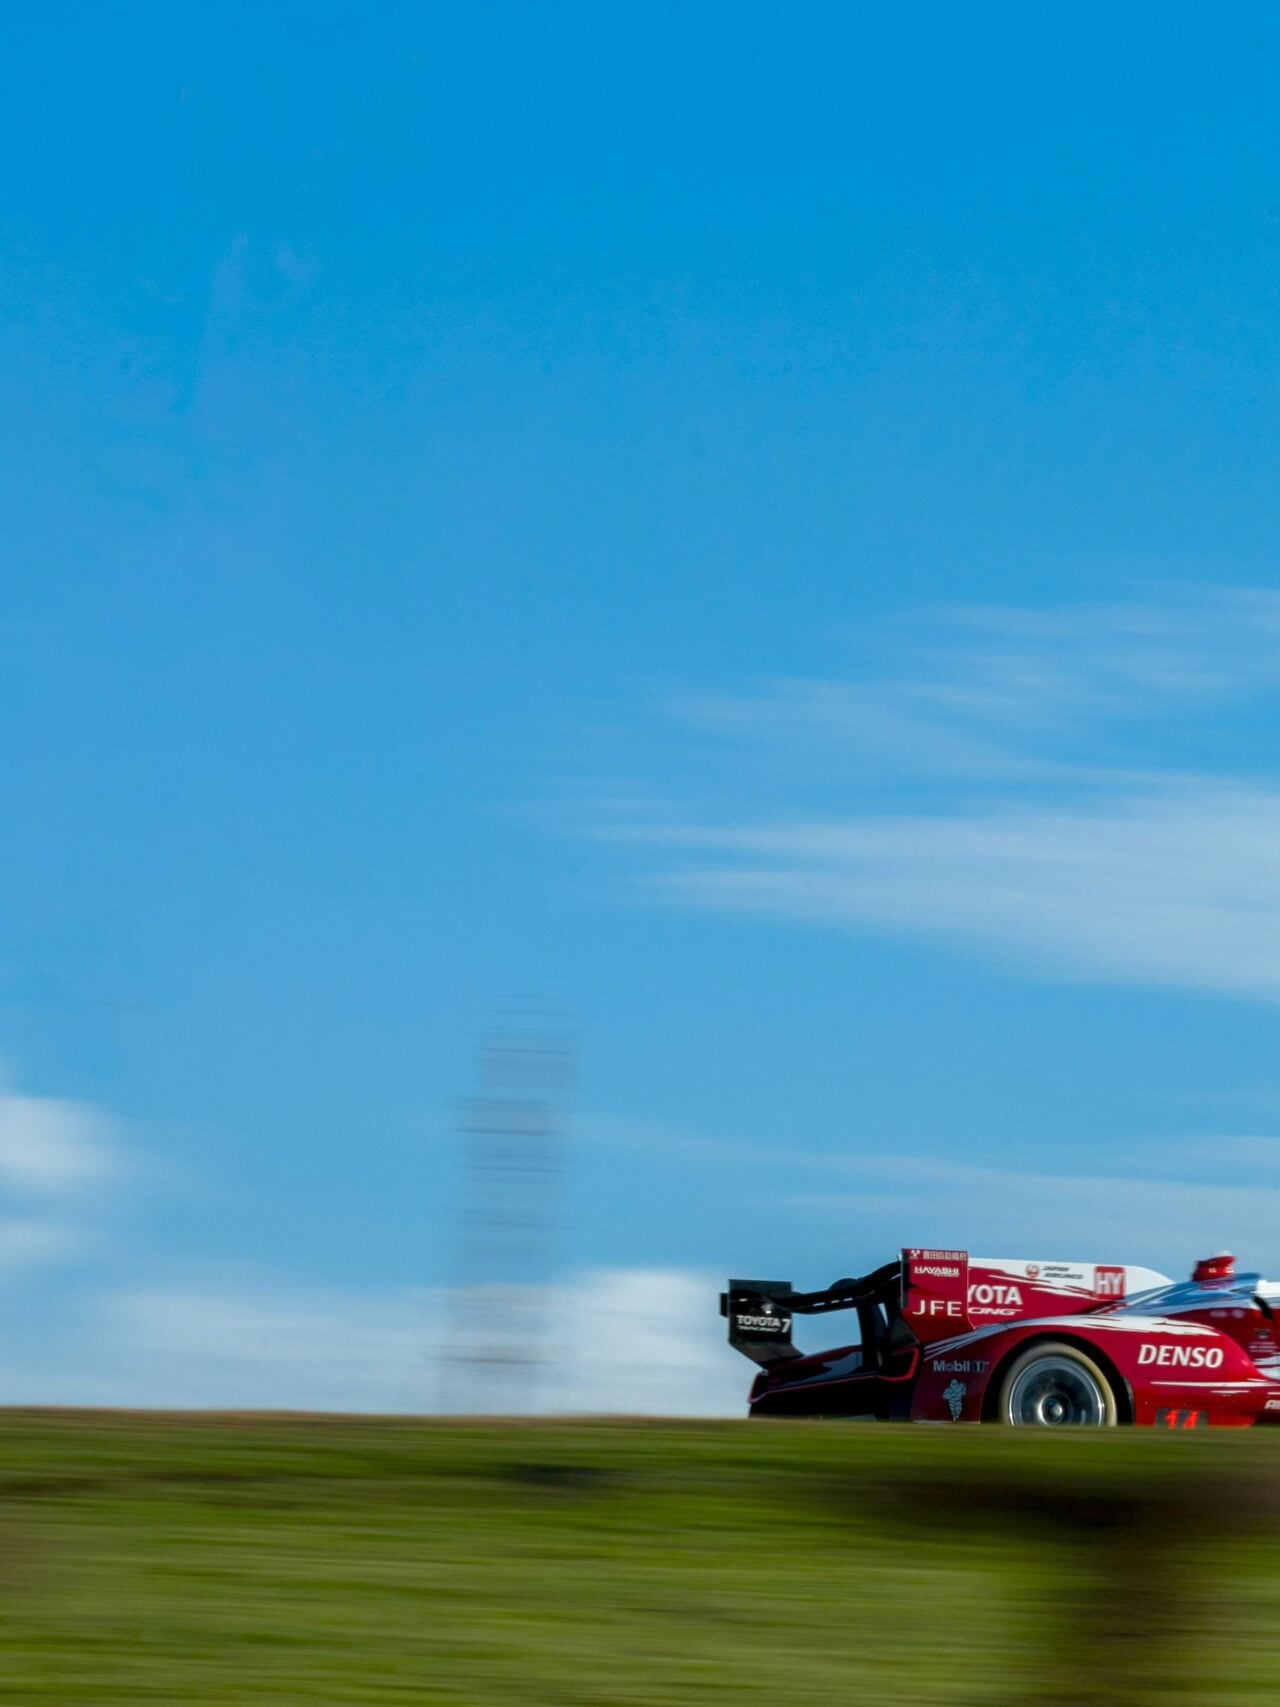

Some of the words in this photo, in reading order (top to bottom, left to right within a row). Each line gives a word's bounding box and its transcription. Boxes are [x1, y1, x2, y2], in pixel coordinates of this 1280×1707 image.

[914, 1266, 959, 1276] HAYASHI
[912, 1300, 962, 1317] JFE
[736, 1315, 781, 1327] TOYOTA
[781, 1318, 792, 1333] 7
[1137, 1344, 1224, 1369] DENSO
[933, 1361, 970, 1372] Mobil
